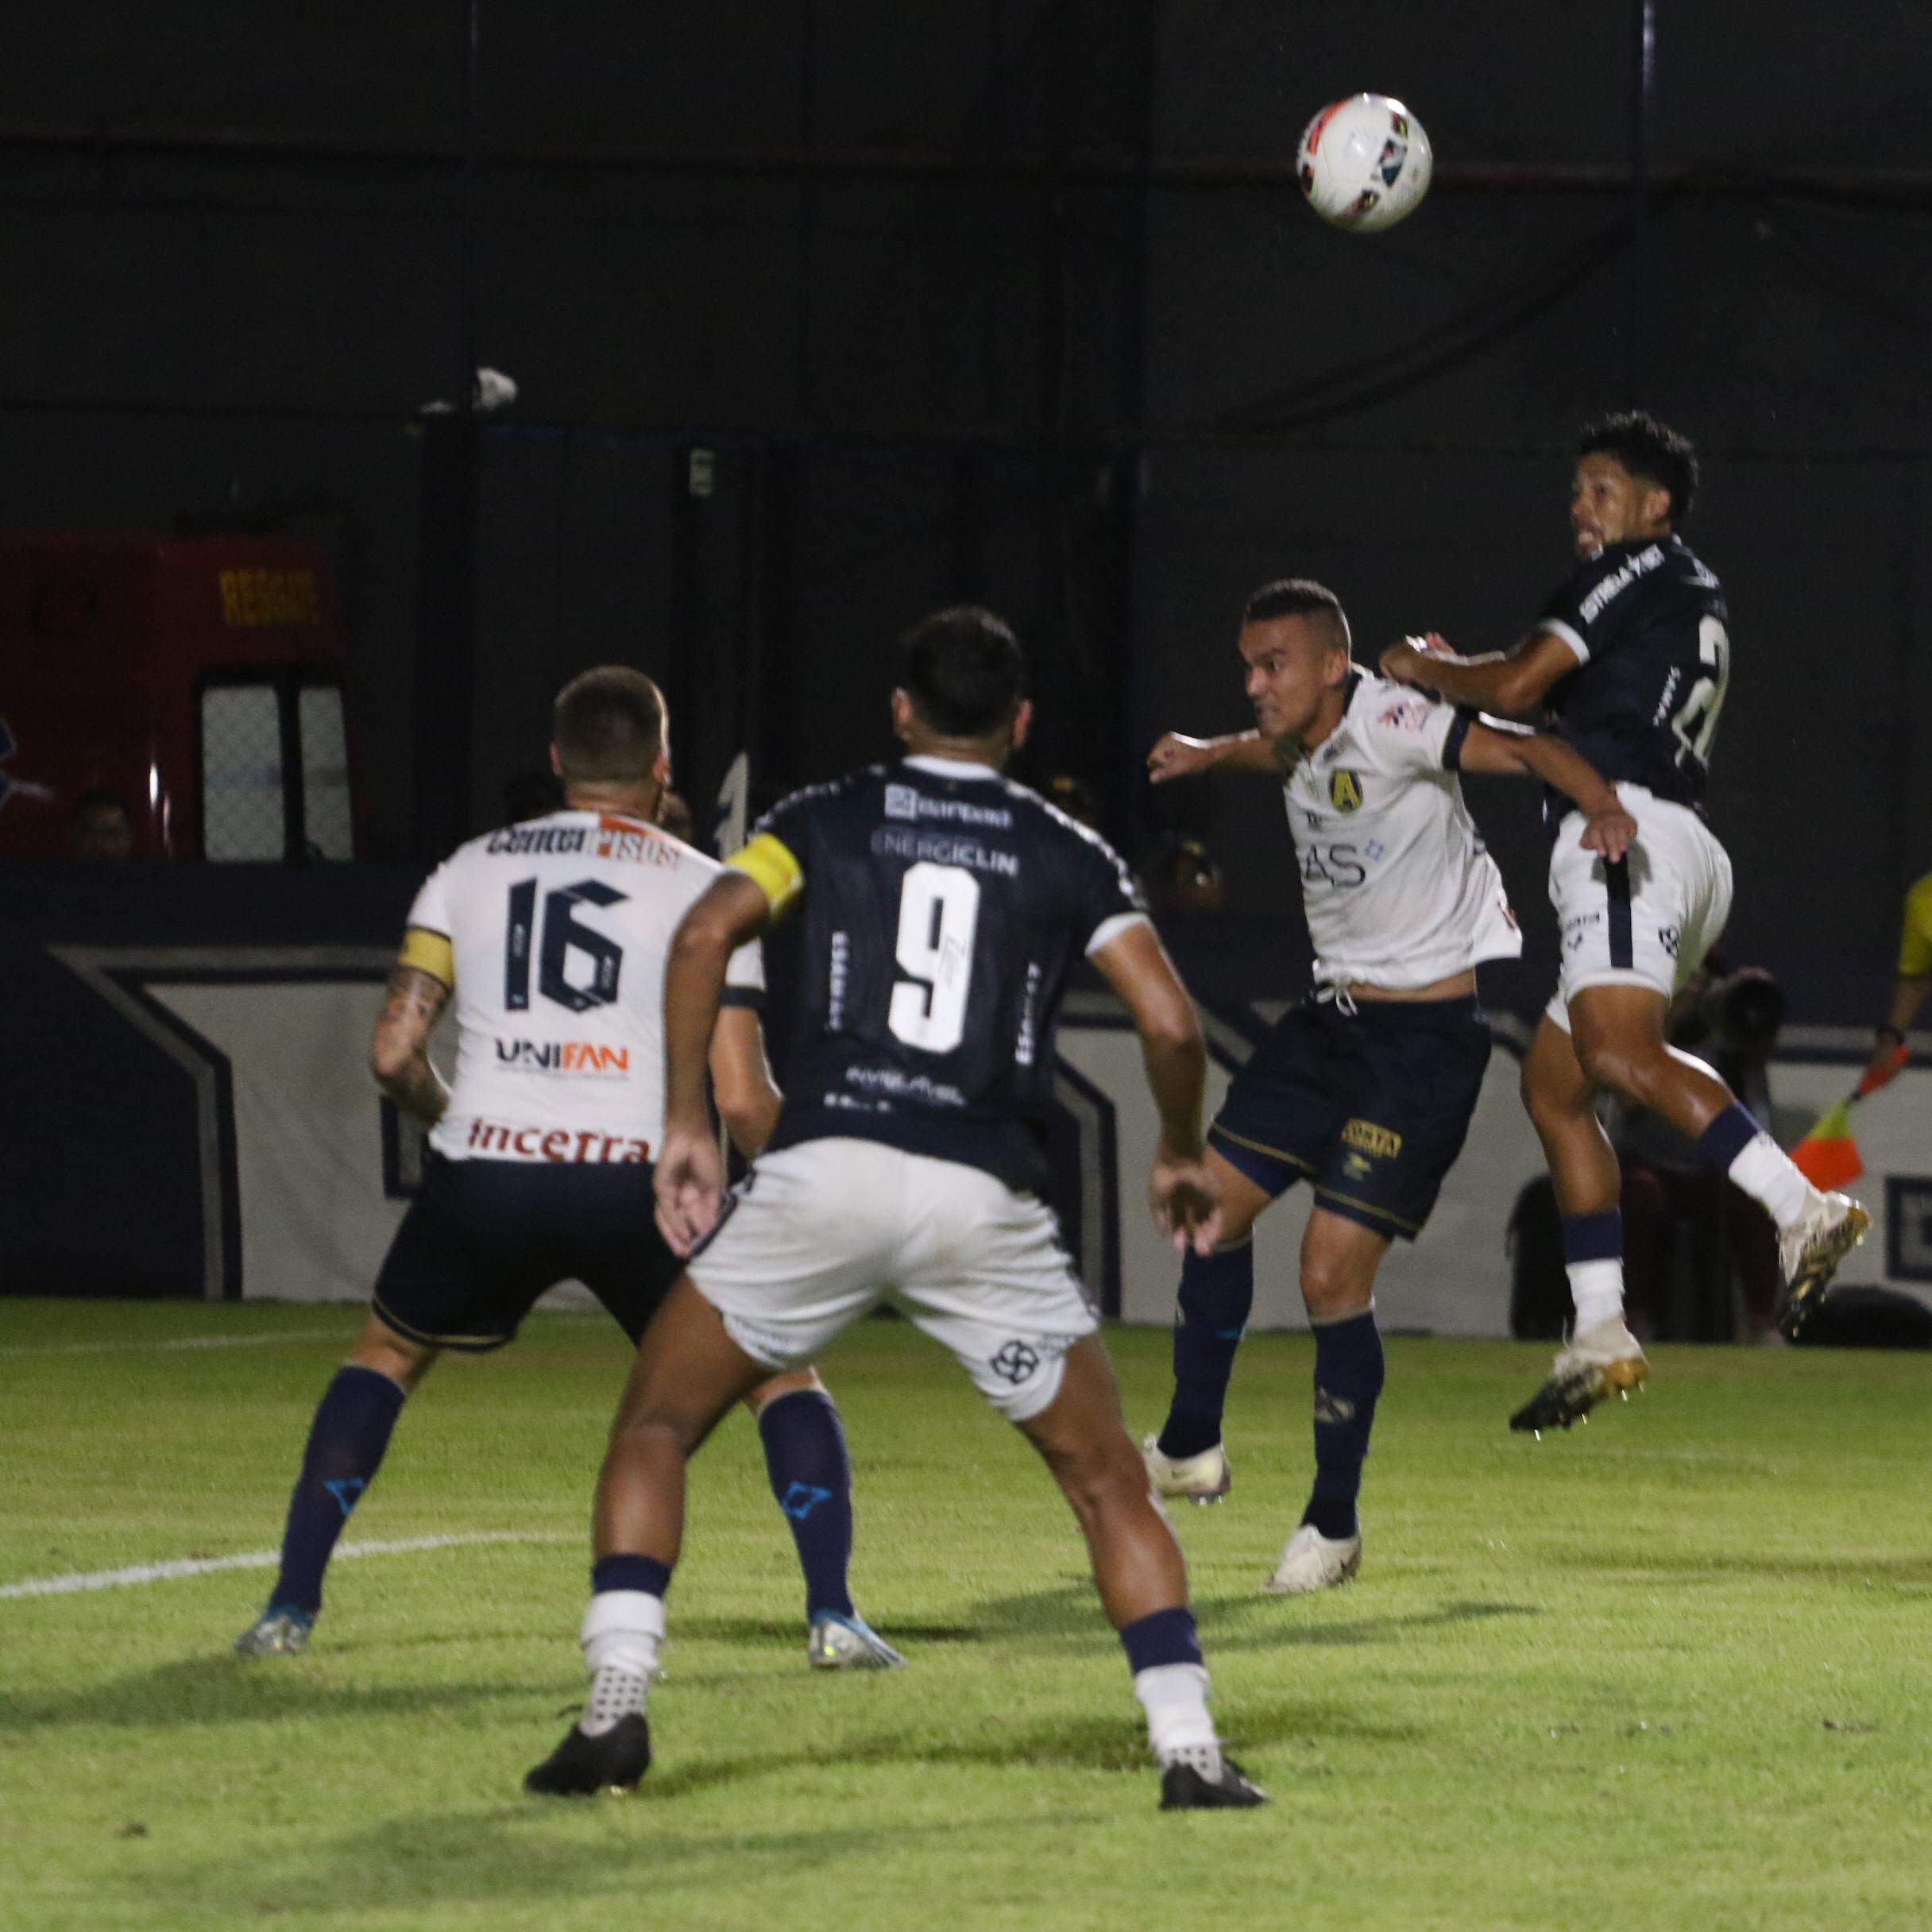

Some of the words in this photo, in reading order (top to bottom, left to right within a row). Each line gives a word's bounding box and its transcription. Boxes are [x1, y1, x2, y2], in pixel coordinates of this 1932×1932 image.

[504, 876, 630, 1014] 16
[887, 861, 980, 1053] 9
[496, 1037, 629, 1070] UNIFAN
